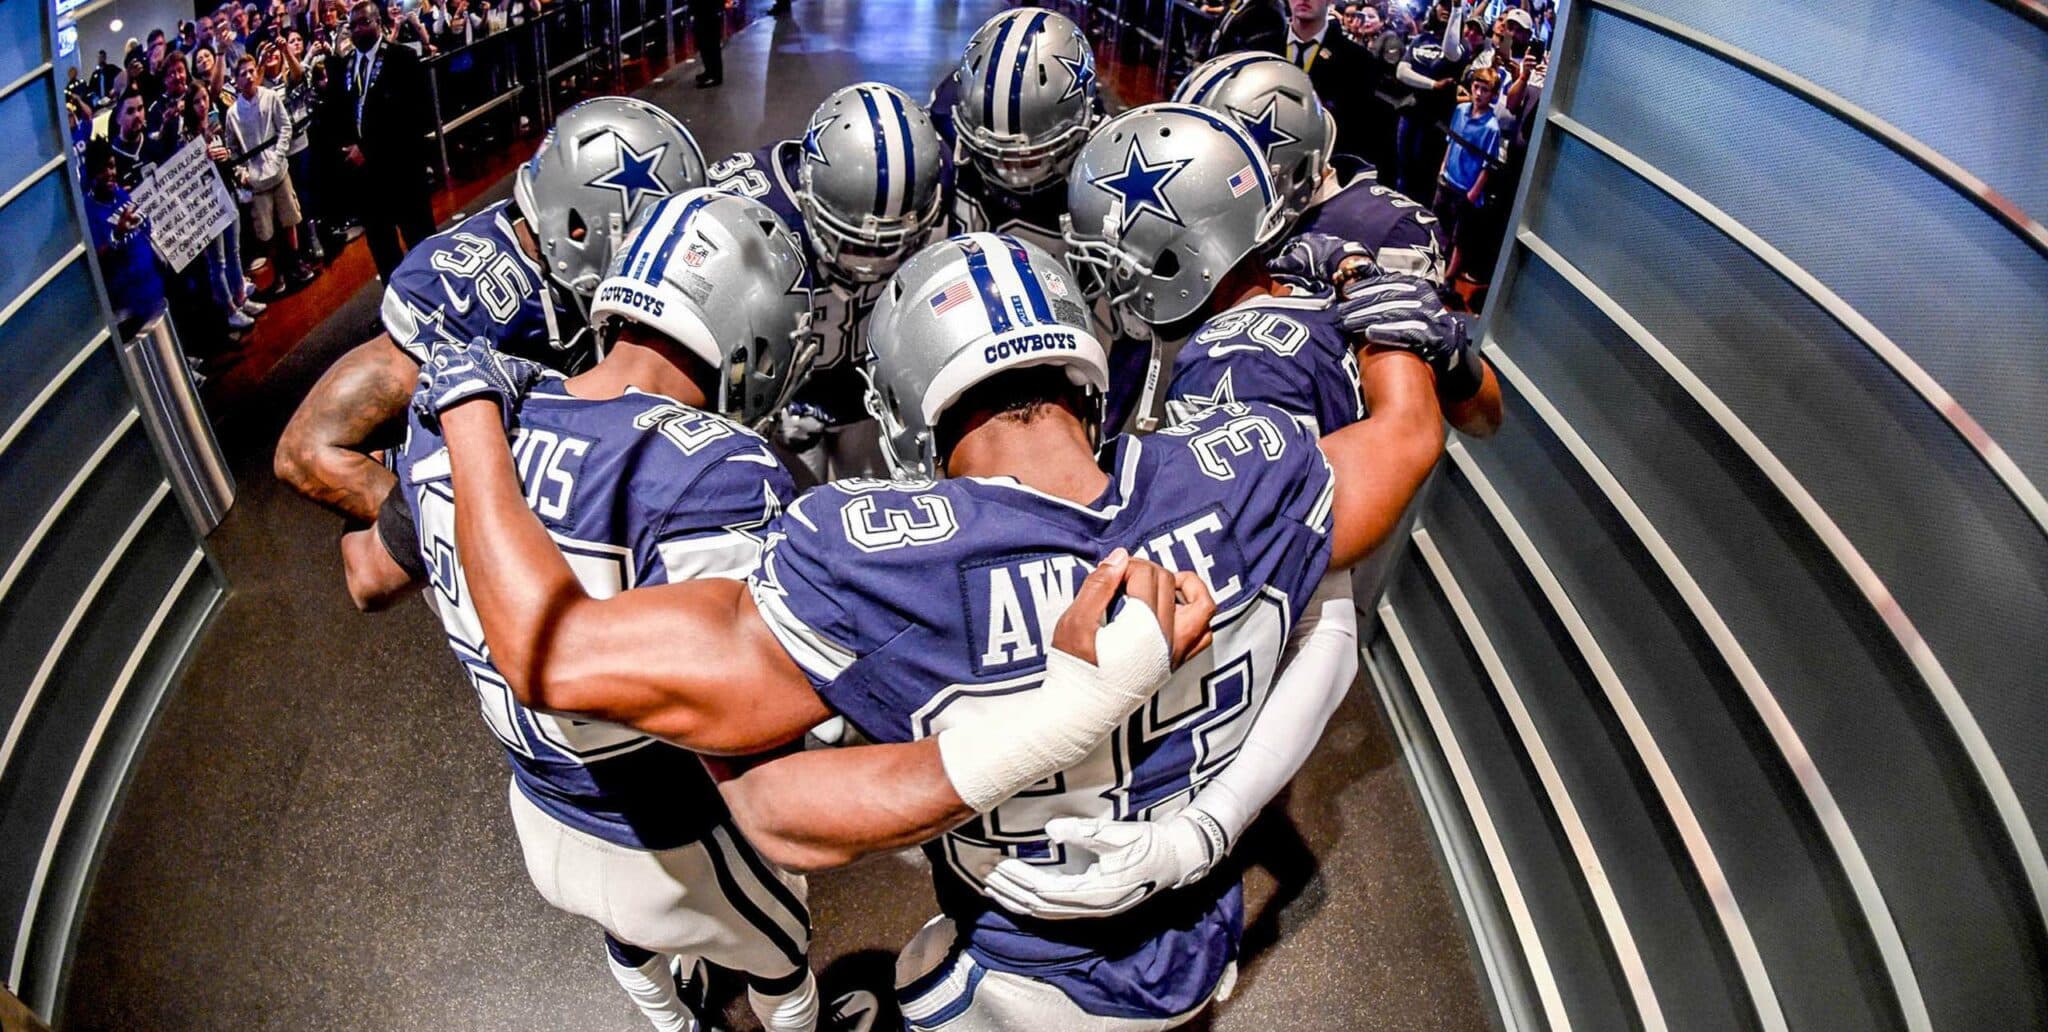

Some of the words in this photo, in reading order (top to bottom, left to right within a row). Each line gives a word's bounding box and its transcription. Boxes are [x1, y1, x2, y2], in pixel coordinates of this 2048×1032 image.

[165, 160, 209, 197] TOUCHDOWN
[178, 148, 203, 171] PLEASE
[706, 152, 772, 199] 32
[153, 208, 168, 224] FOR
[167, 199, 179, 212] ME
[178, 180, 200, 201] TODAY
[173, 210, 187, 225] ALL
[186, 198, 199, 212] THE
[199, 185, 214, 201] WAY
[175, 226, 186, 238] NY
[185, 217, 196, 229] TO
[195, 205, 209, 222] SEE
[208, 197, 220, 209] MY
[206, 206, 227, 227] GAME
[430, 232, 533, 325] 35
[600, 285, 666, 318] COWBOYS
[984, 332, 1077, 364] COWBOYS
[1195, 310, 1310, 357] 30
